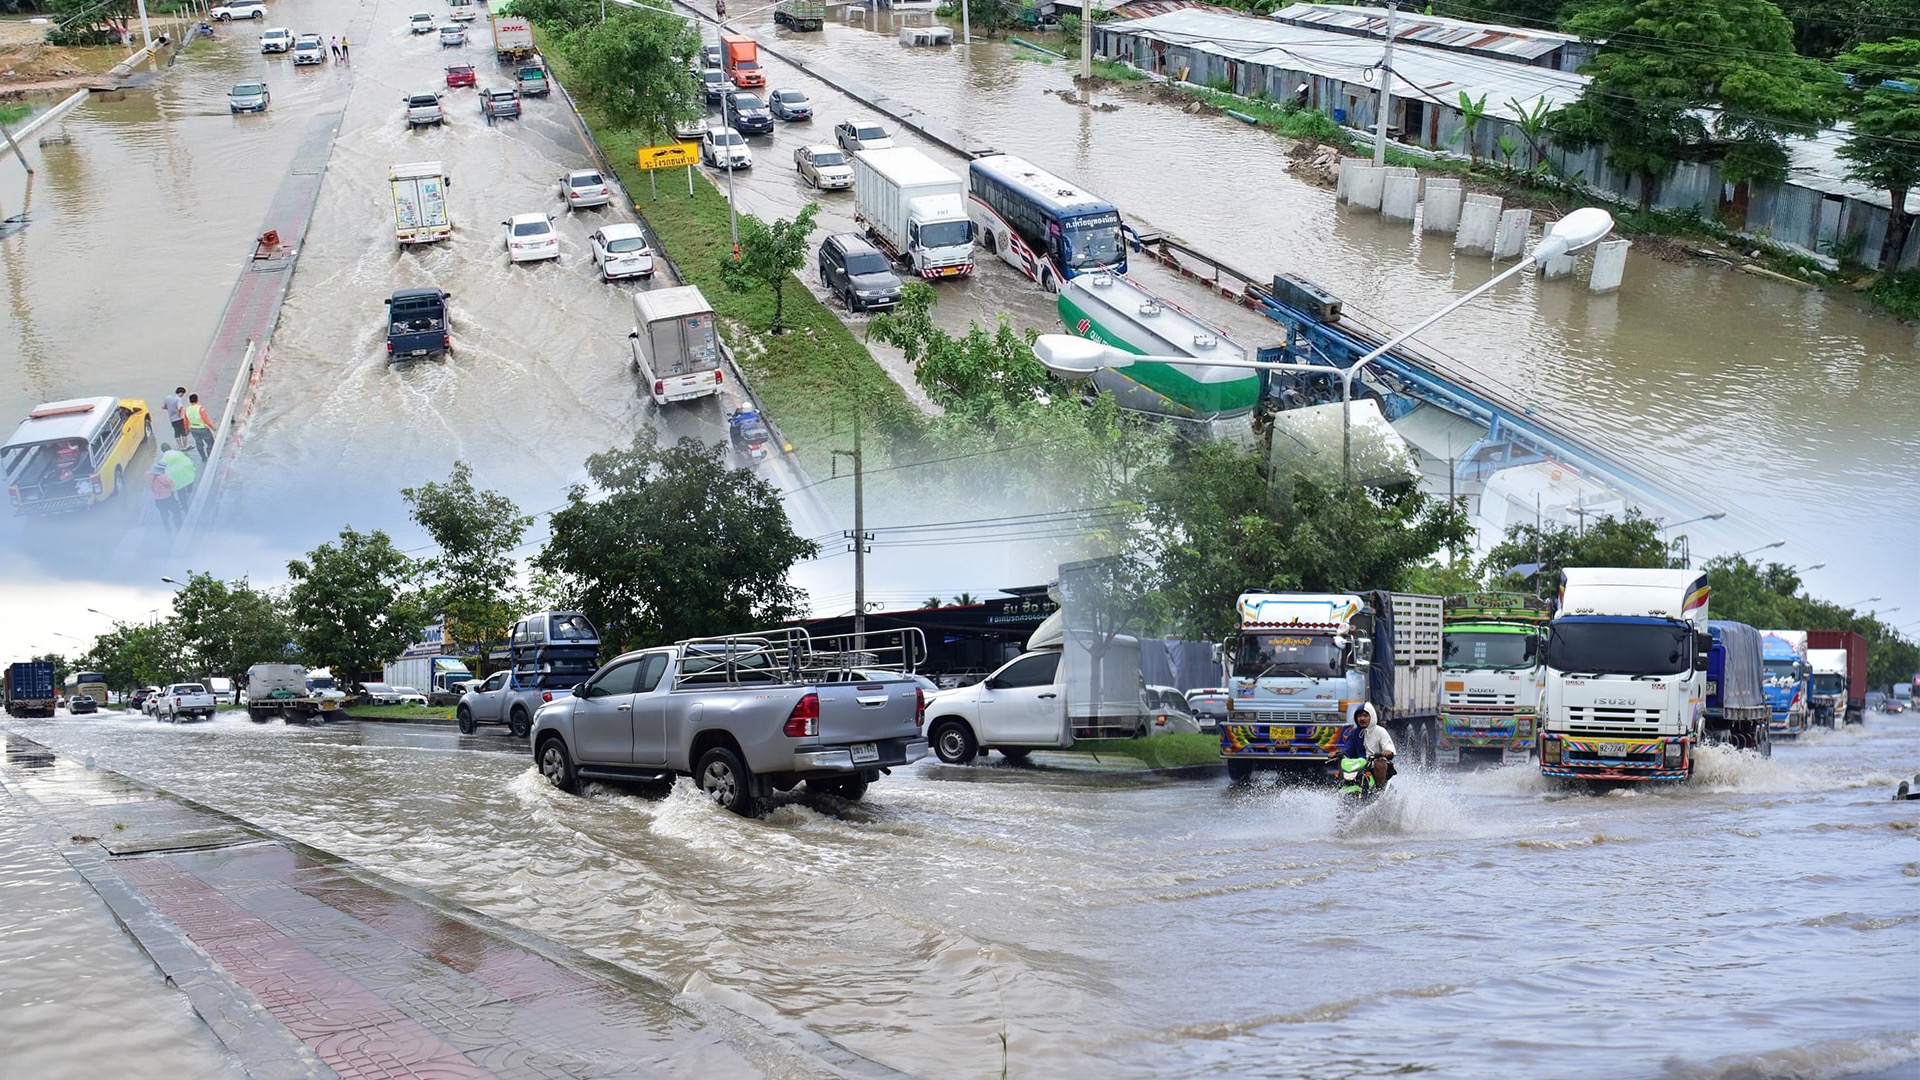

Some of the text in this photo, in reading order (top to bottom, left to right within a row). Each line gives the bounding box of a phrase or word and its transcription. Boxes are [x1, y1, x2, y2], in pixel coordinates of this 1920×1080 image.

[644, 156, 695, 168] ระวังรถชนท้าย
[1003, 597, 1060, 614] รับ ซื้อ ขา
[1593, 698, 1636, 706] ISUZU
[1599, 743, 1626, 753] 82-7747
